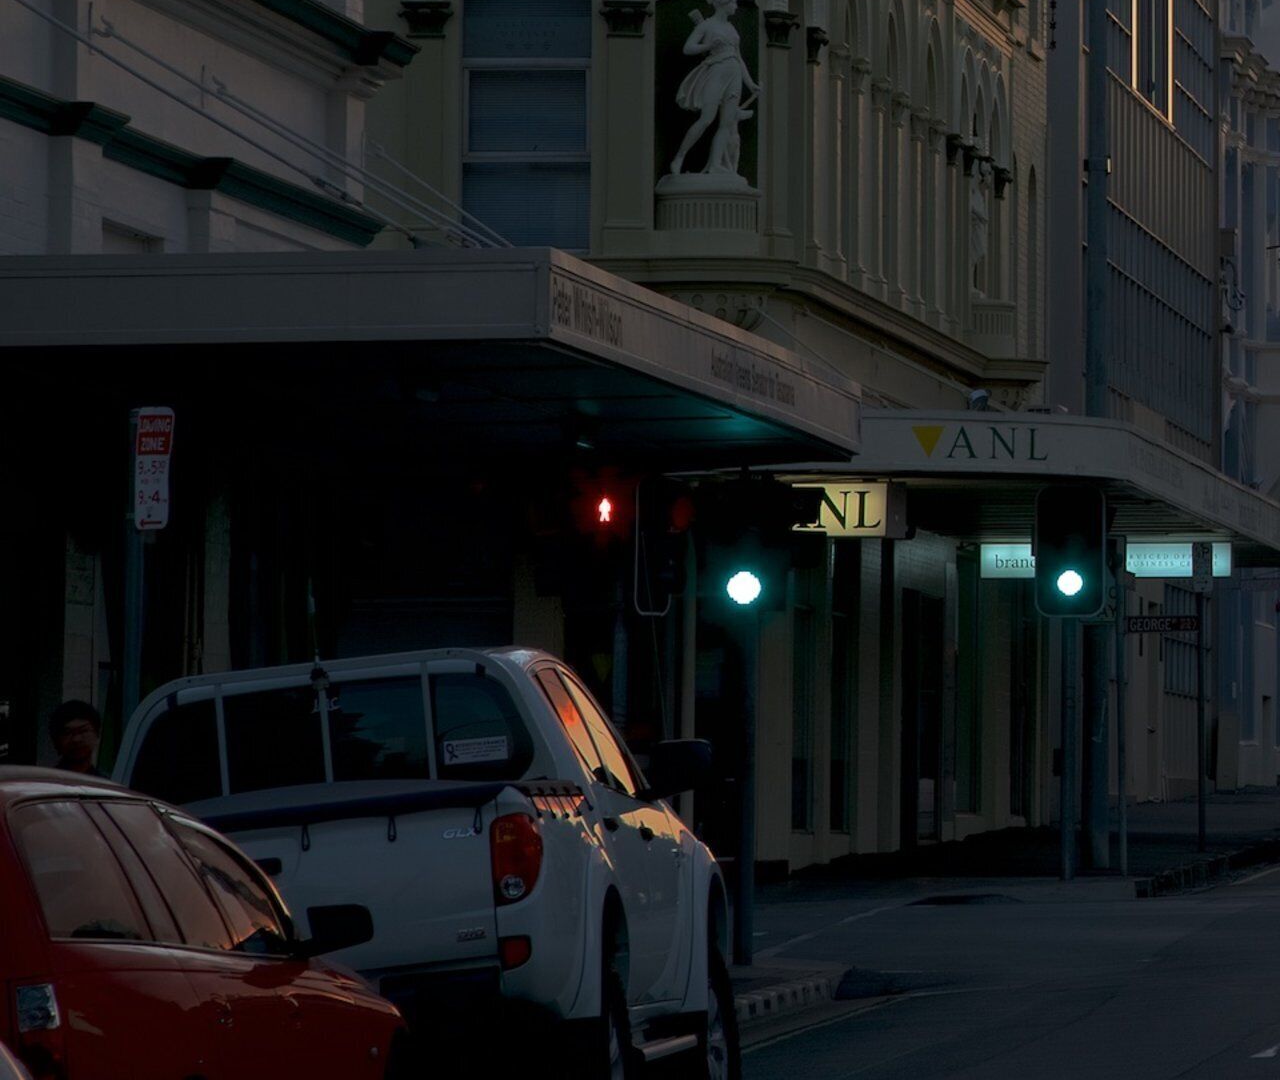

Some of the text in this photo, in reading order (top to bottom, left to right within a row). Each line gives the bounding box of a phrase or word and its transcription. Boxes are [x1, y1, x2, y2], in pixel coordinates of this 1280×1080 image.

[552, 277, 572, 327] Peter
[947, 425, 1049, 461] ANL
[797, 491, 881, 530] NL
[1130, 618, 1172, 631] GEORGE
[443, 827, 477, 839] GLX
